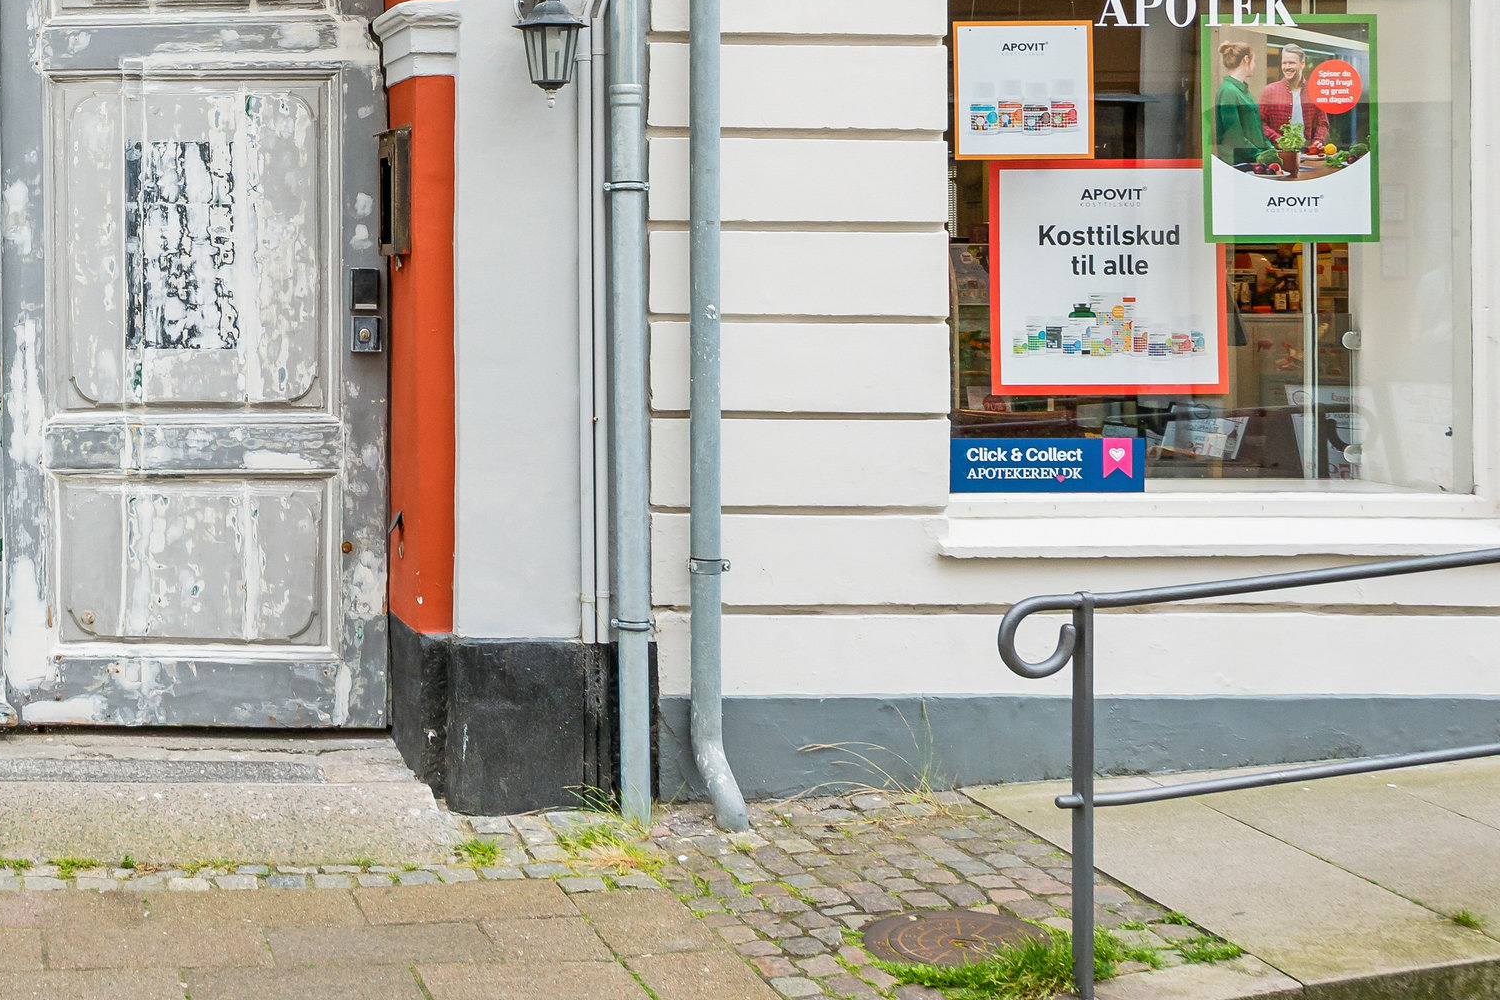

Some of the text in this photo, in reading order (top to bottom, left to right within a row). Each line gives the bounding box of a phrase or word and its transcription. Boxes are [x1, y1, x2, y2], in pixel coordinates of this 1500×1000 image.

[1318, 70, 1341, 78] Spiser
[1316, 79, 1353, 87] 600g frugt
[1329, 96, 1354, 104] dagen?
[1037, 224, 1181, 247] Kosttilskud
[1070, 254, 1150, 276] til alle
[966, 446, 1083, 463] Click & Collect
